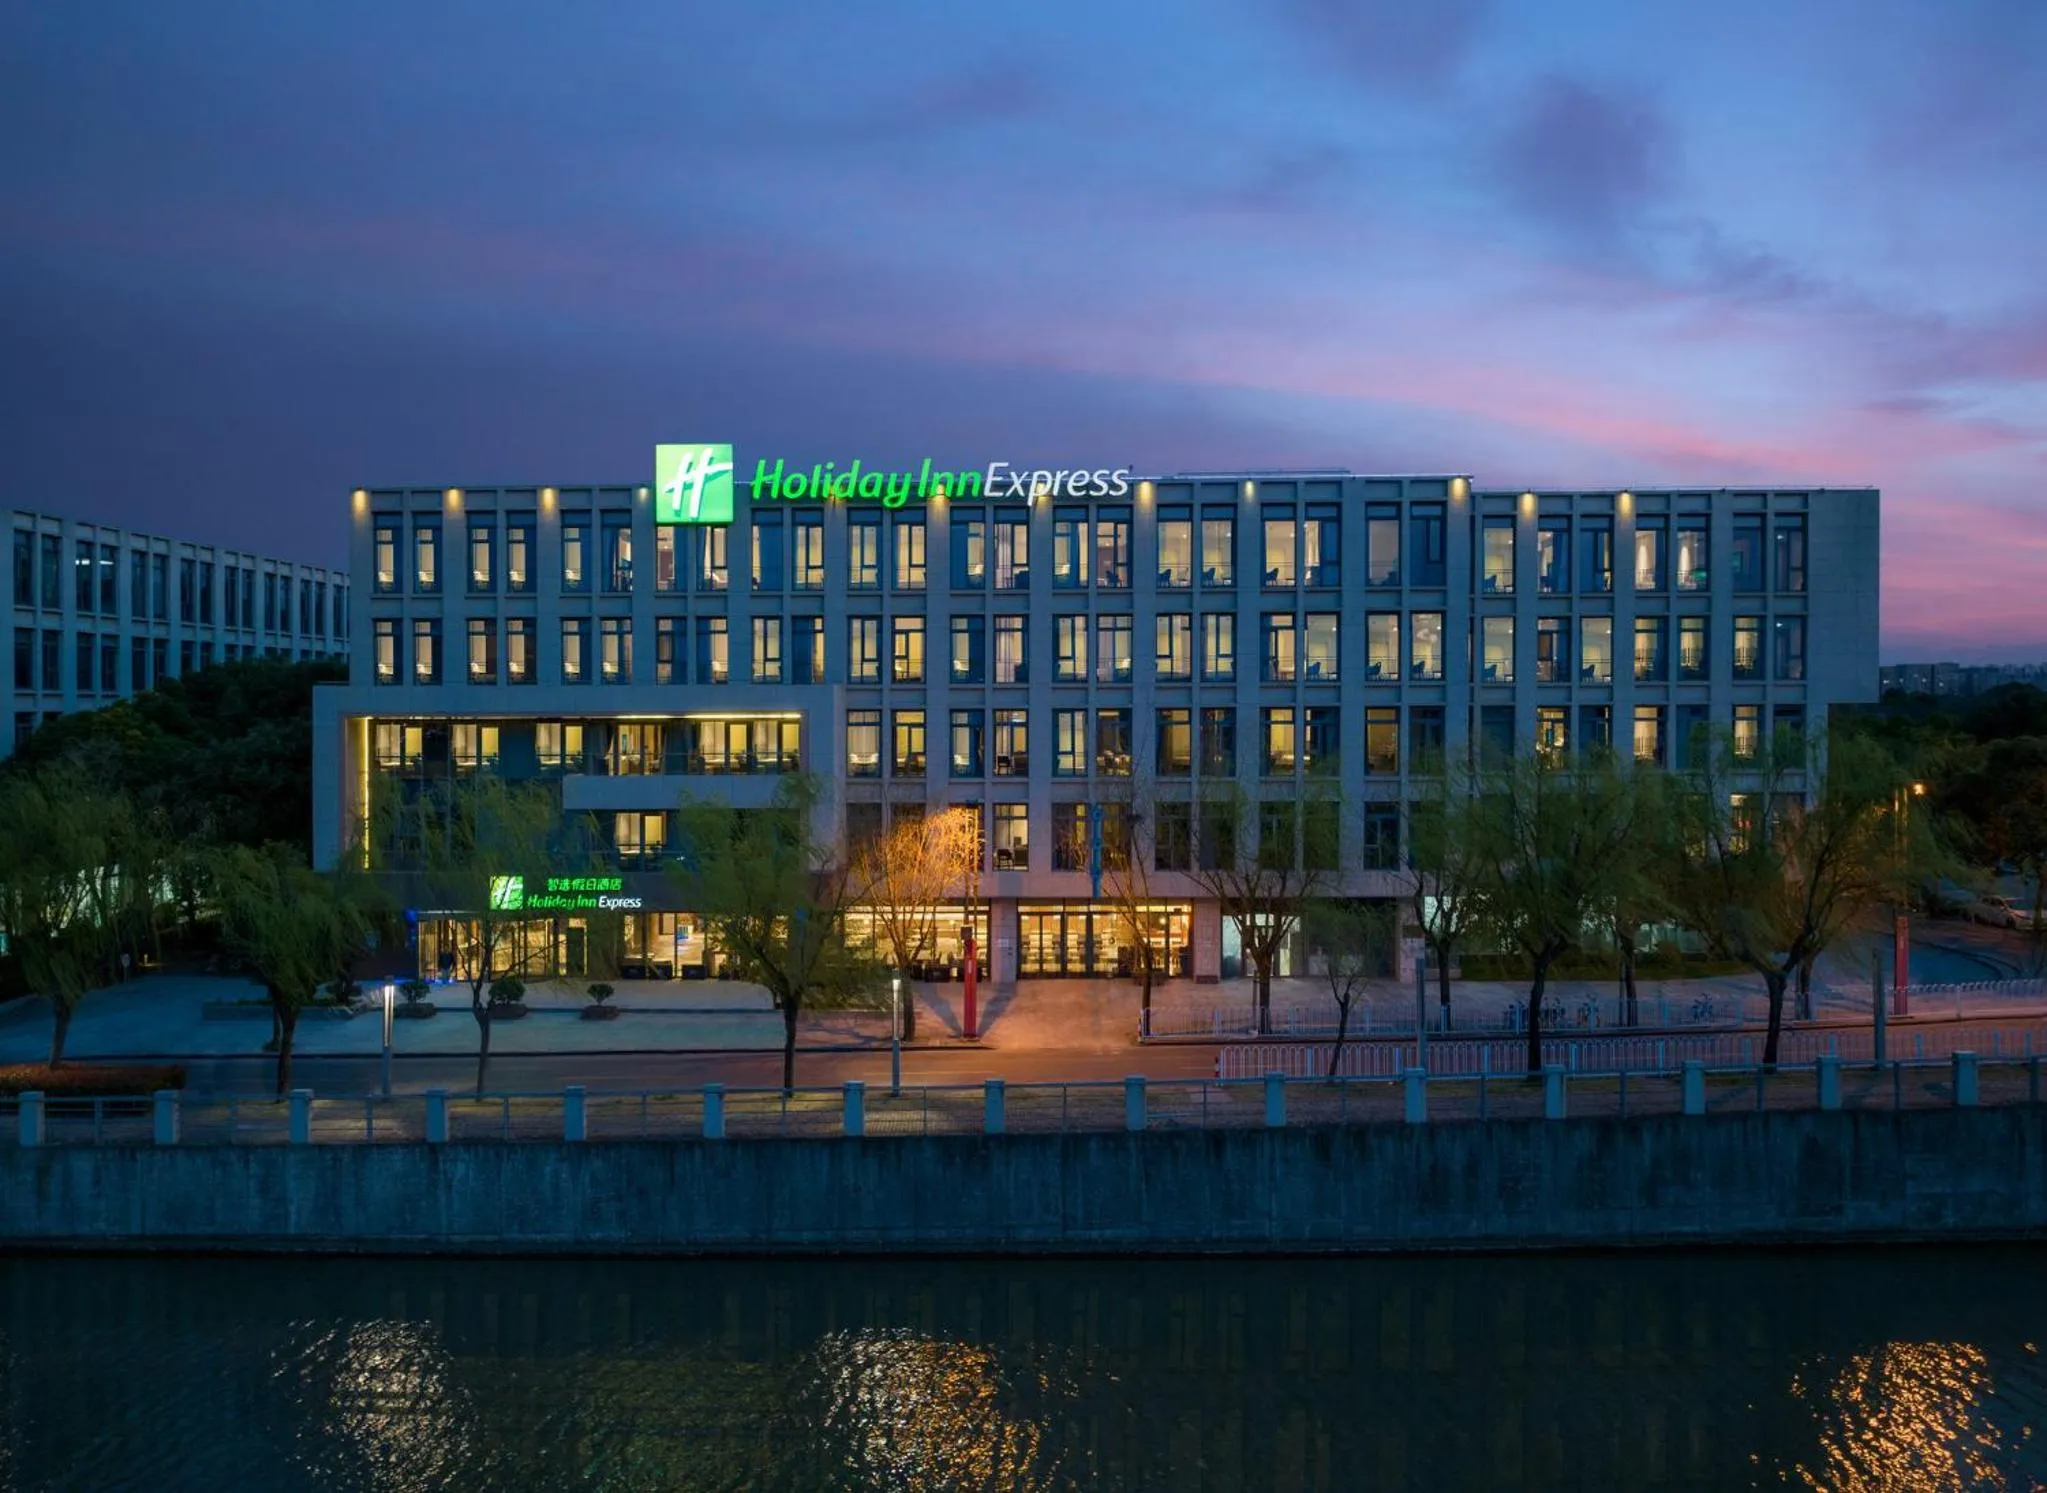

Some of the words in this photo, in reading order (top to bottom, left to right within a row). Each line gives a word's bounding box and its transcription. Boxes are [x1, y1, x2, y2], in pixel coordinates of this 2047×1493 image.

[751, 458, 911, 508] Holiday
[917, 457, 982, 498] Inn
[983, 461, 1130, 507] Express
[547, 878, 622, 891] 智选假日酒店
[527, 894, 576, 910] Holiday
[577, 894, 597, 908] Inn
[598, 895, 642, 911] Express
